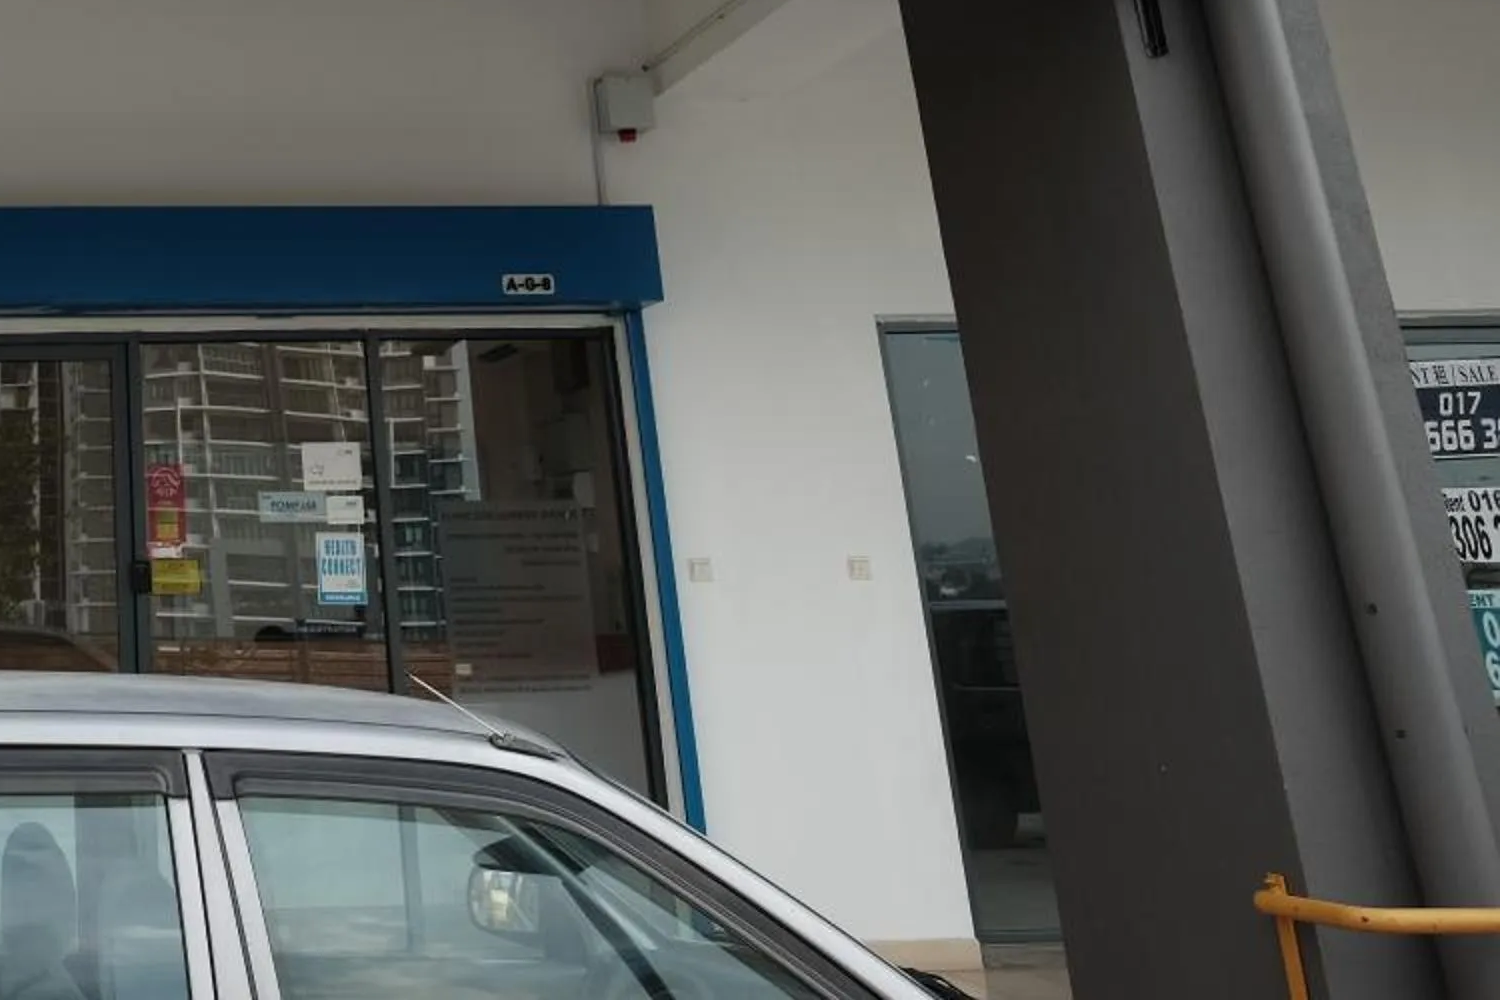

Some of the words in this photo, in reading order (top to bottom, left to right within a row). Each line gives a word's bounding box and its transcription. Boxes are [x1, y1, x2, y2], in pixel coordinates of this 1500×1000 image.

[1439, 391, 1481, 417] 017
[1424, 420, 1475, 451] 666
[1449, 515, 1492, 560] 306
